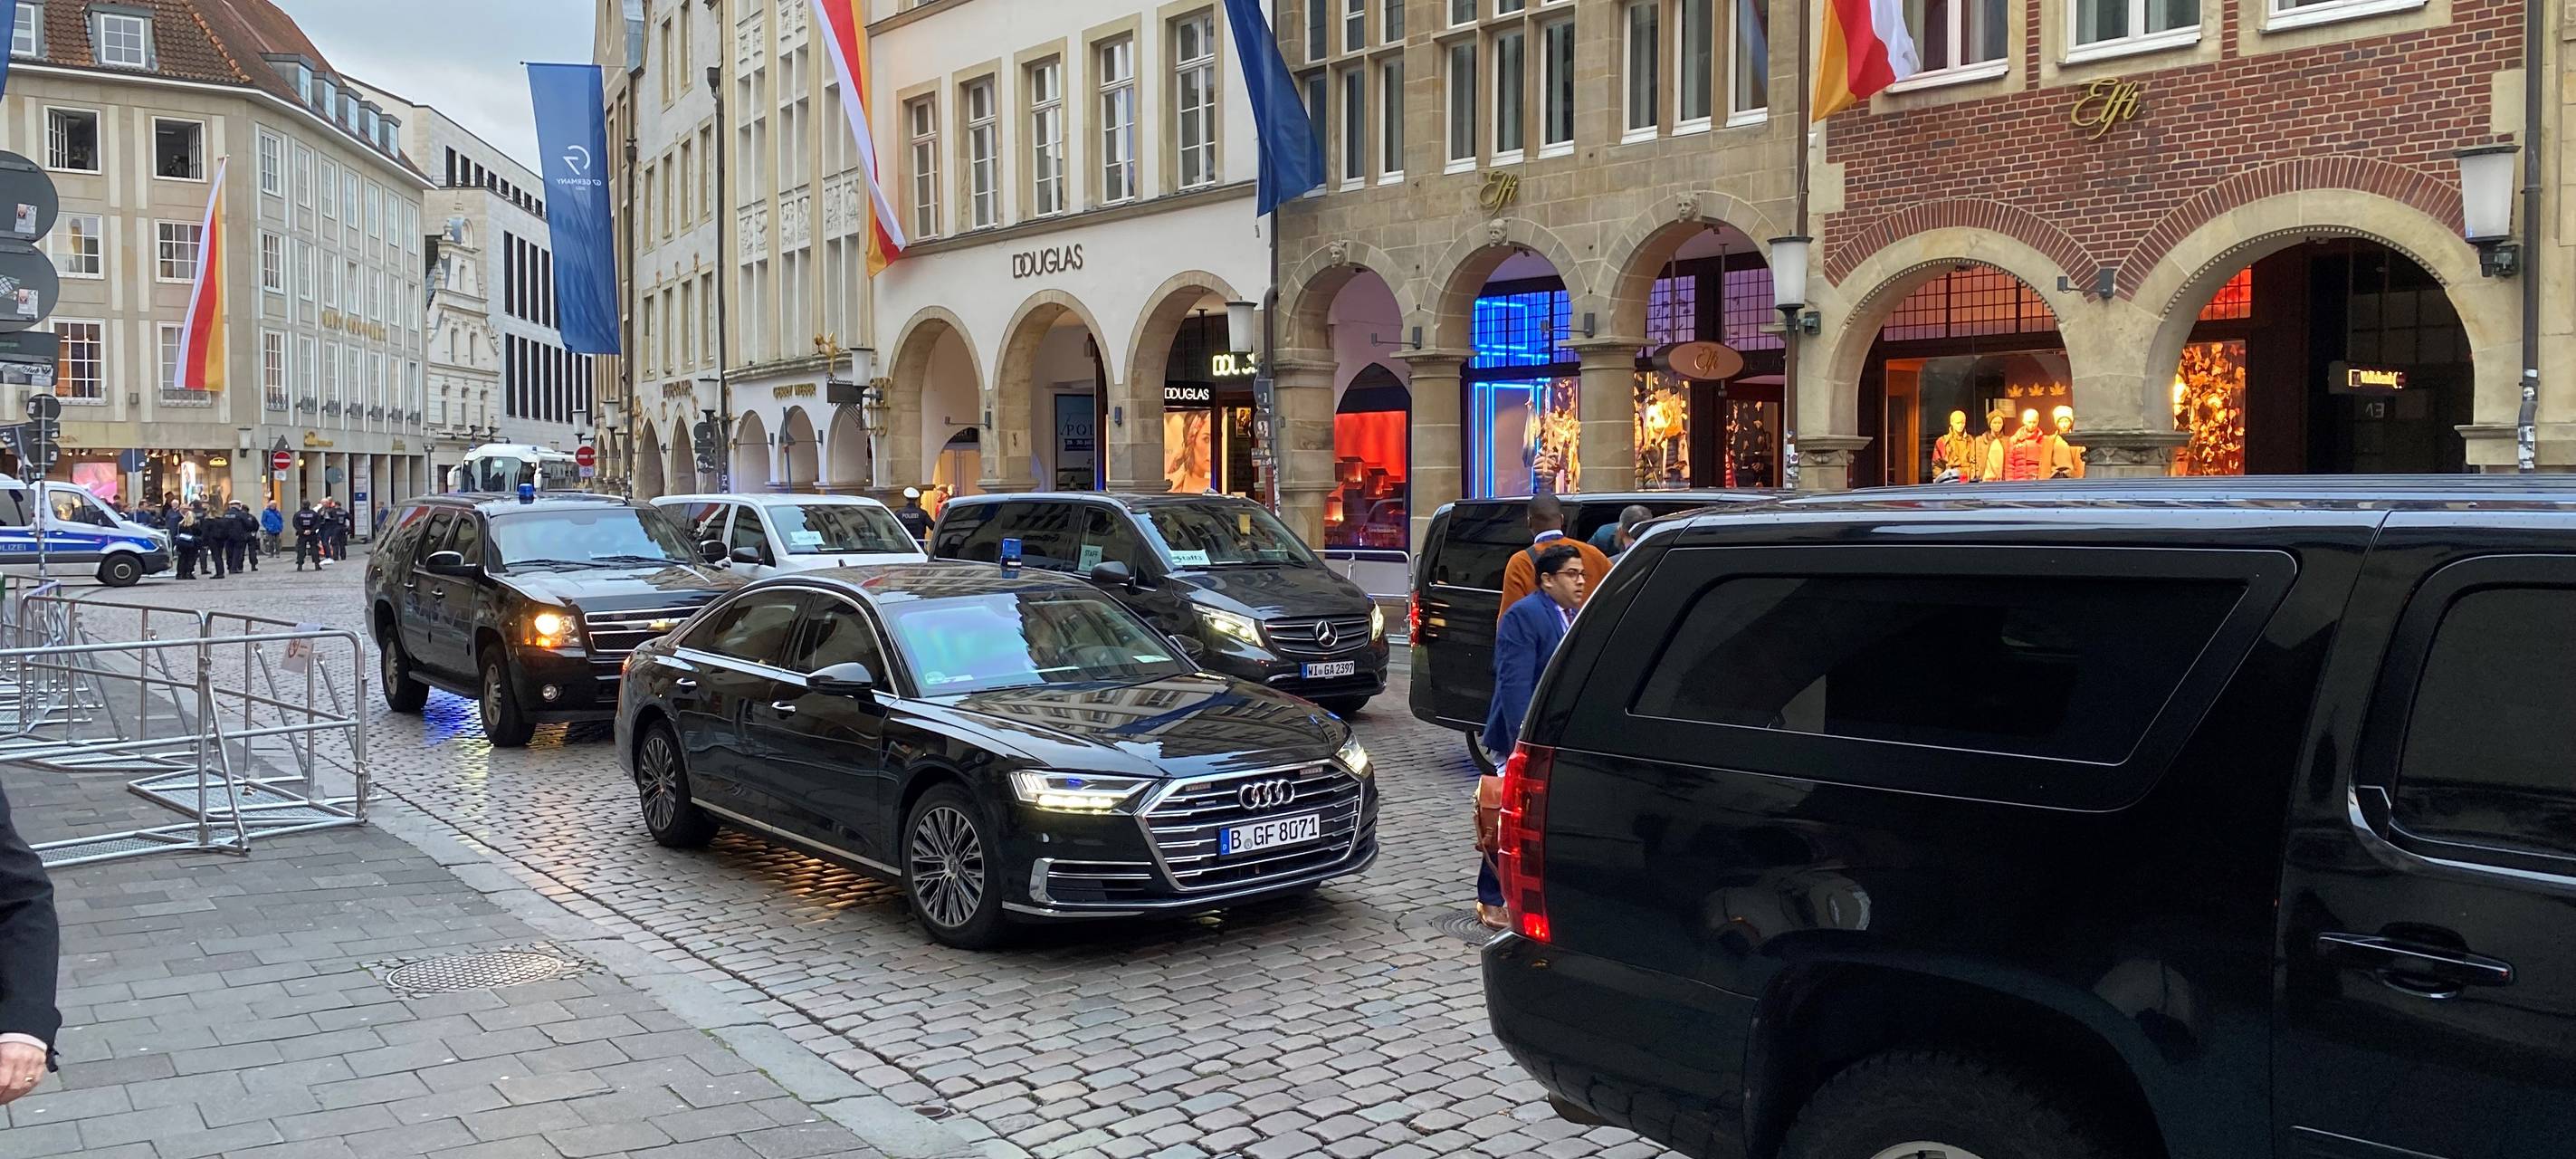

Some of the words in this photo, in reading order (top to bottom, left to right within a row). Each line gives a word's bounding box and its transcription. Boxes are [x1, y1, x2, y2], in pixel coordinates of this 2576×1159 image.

[2071, 78, 2141, 140] Elfi
[1479, 169, 1519, 216] Elfi
[1012, 244, 1083, 279] DOUGLAS
[1164, 388, 1210, 400] DOUGLAS
[0, 543, 27, 551] LIZEI
[1308, 665, 1318, 676] WI
[1231, 829, 1242, 850] B
[1254, 823, 1275, 846] GF
[1279, 817, 1318, 842] 8071
